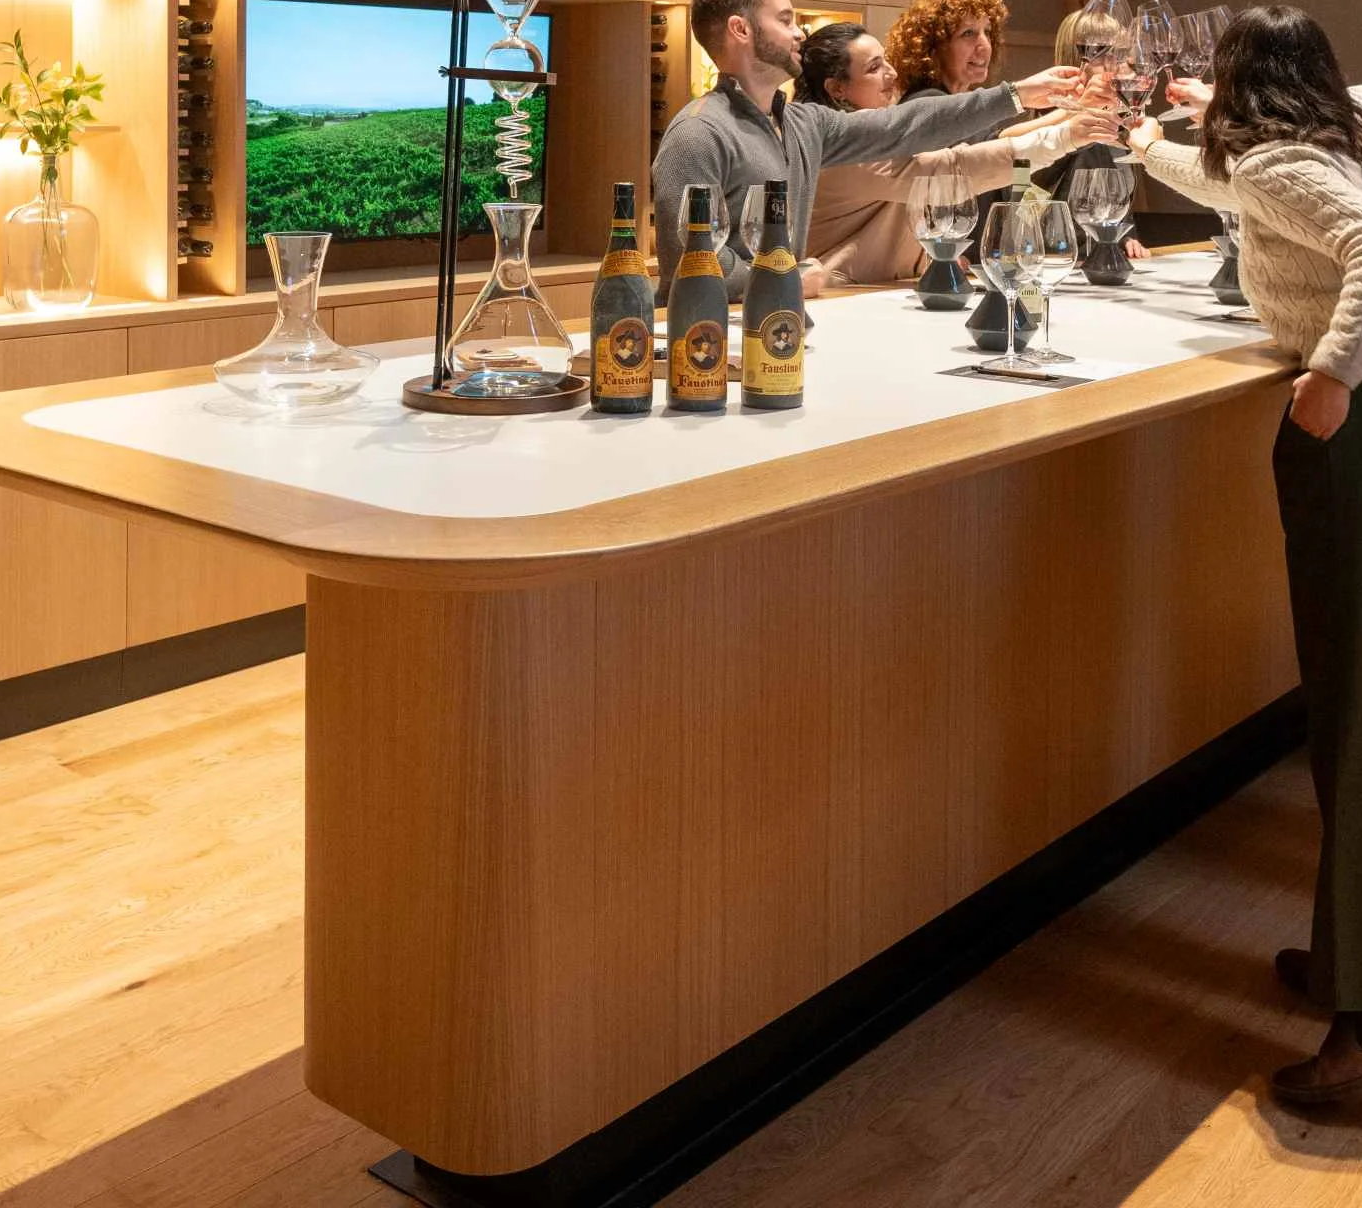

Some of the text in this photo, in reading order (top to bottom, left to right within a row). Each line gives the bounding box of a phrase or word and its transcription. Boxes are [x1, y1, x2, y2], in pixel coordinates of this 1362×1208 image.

[760, 362, 798, 376] Faustino
[601, 371, 648, 385] Faustino
[677, 374, 723, 388] Faustino
